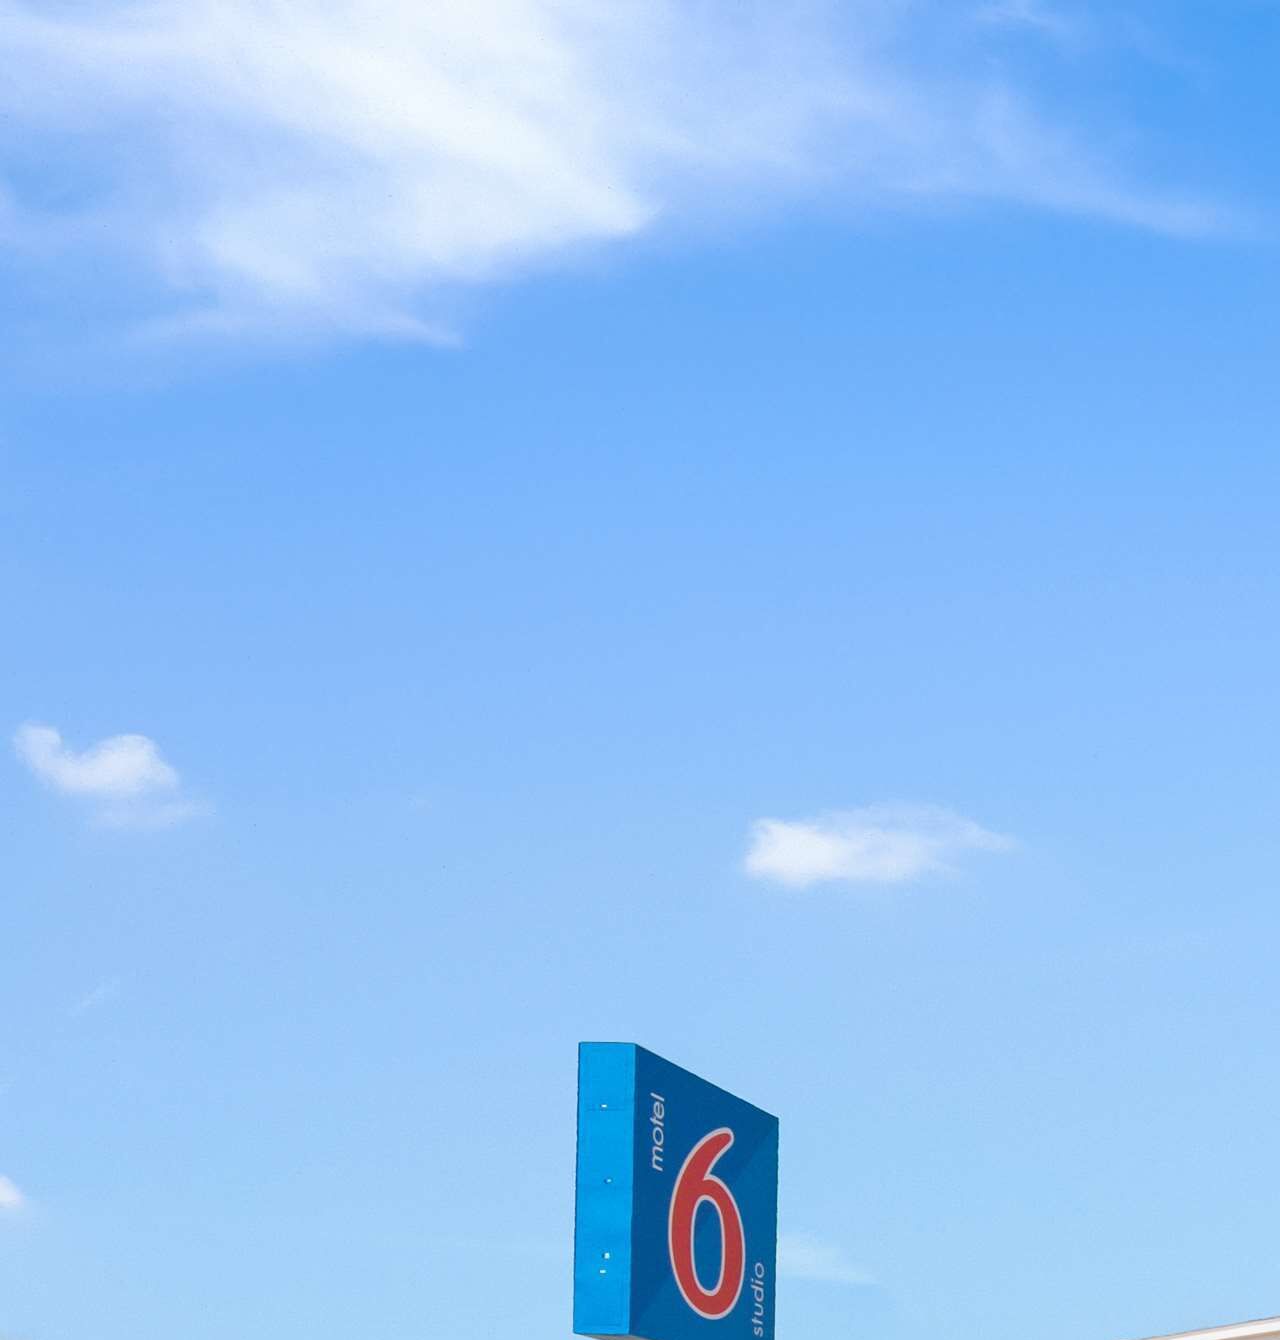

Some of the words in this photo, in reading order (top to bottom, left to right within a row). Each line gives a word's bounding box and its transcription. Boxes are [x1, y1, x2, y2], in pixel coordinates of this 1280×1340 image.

[650, 1092, 665, 1172] motel
[668, 1127, 746, 1321] 6
[752, 1261, 765, 1337] studio
